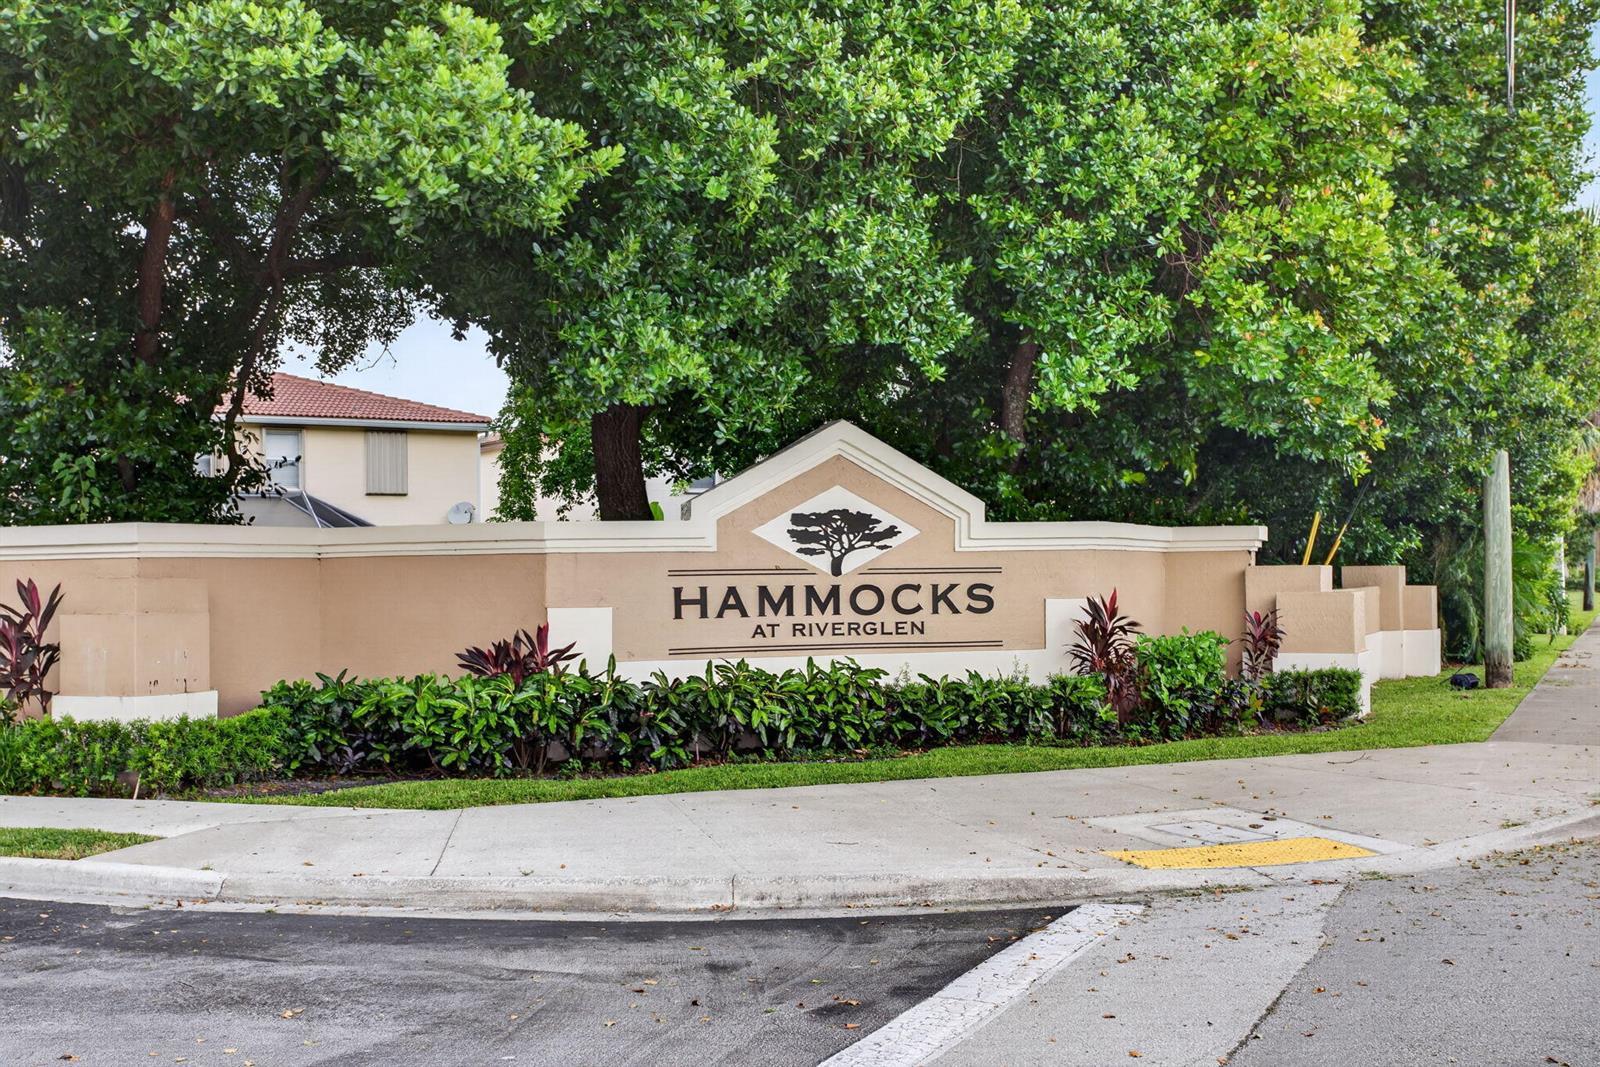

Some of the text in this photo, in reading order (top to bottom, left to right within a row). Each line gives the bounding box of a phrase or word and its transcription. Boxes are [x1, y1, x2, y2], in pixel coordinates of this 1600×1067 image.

[672, 582, 996, 620] HAMMOCKS
[751, 620, 925, 639] AT RIVERGLEN
